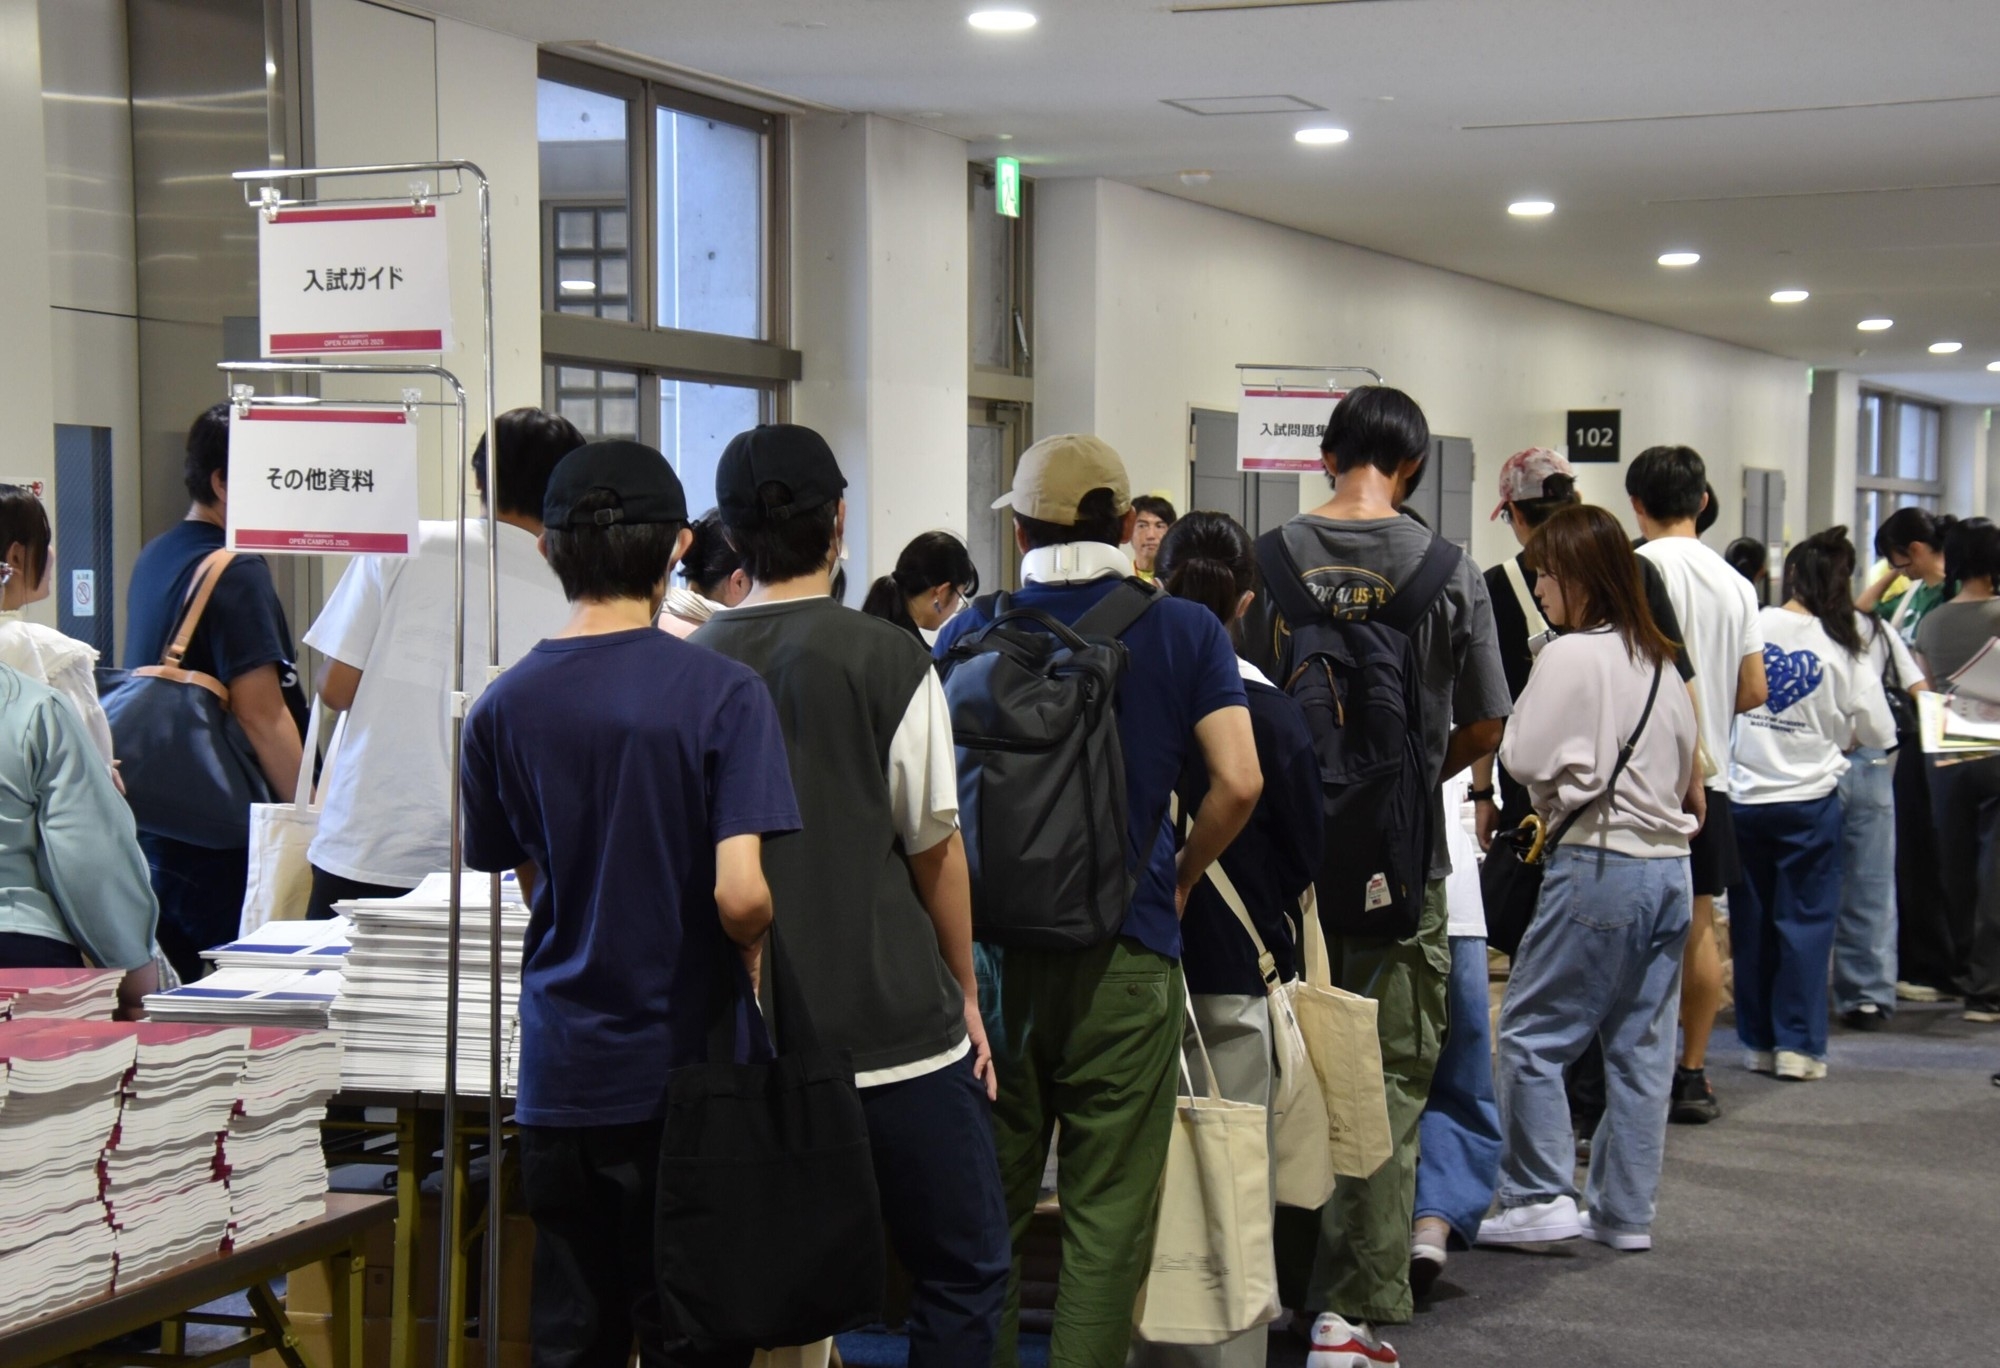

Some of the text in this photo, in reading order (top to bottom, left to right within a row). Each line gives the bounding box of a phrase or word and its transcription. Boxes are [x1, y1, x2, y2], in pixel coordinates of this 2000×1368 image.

[303, 266, 403, 292] 入試ガイド
[324, 339, 341, 347] OPEN
[342, 338, 369, 346] CAMPUS
[1576, 428, 1613, 447] 102
[266, 468, 374, 493] その他資料
